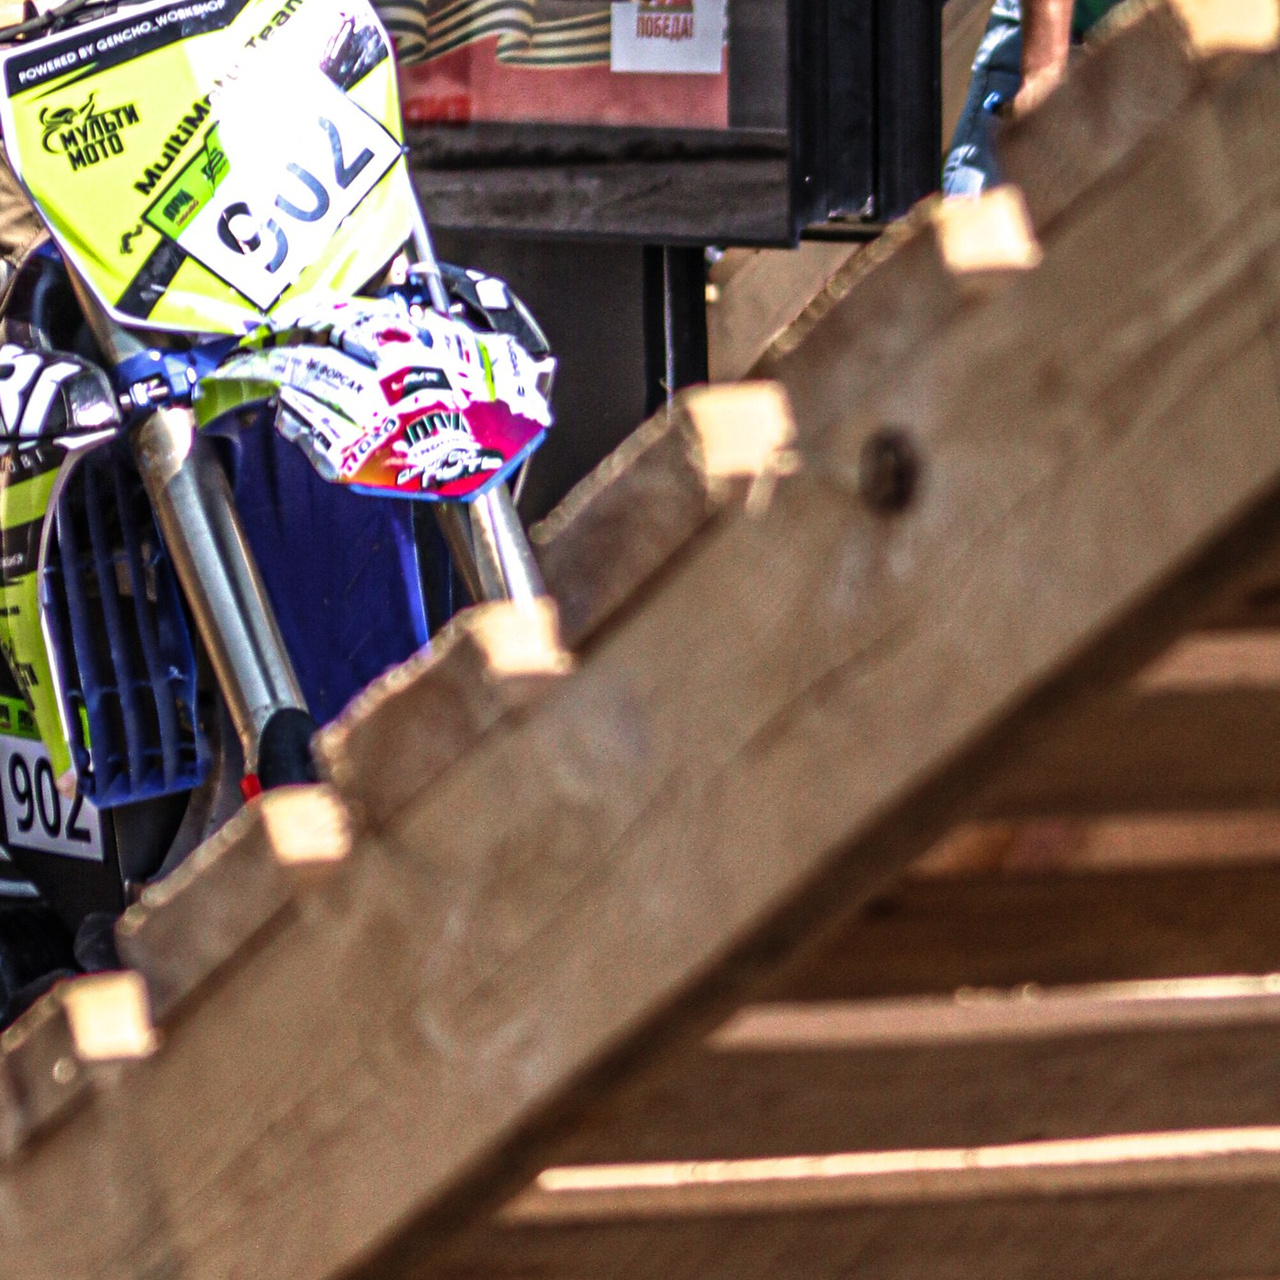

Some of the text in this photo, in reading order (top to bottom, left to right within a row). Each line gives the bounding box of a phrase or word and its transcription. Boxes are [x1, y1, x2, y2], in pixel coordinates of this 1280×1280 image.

[18, 52, 78, 84] POWERED
[78, 43, 97, 60] BY
[59, 103, 140, 152] МУЛЬТИ
[67, 132, 125, 172] МОТО
[8, 751, 93, 844] 902
